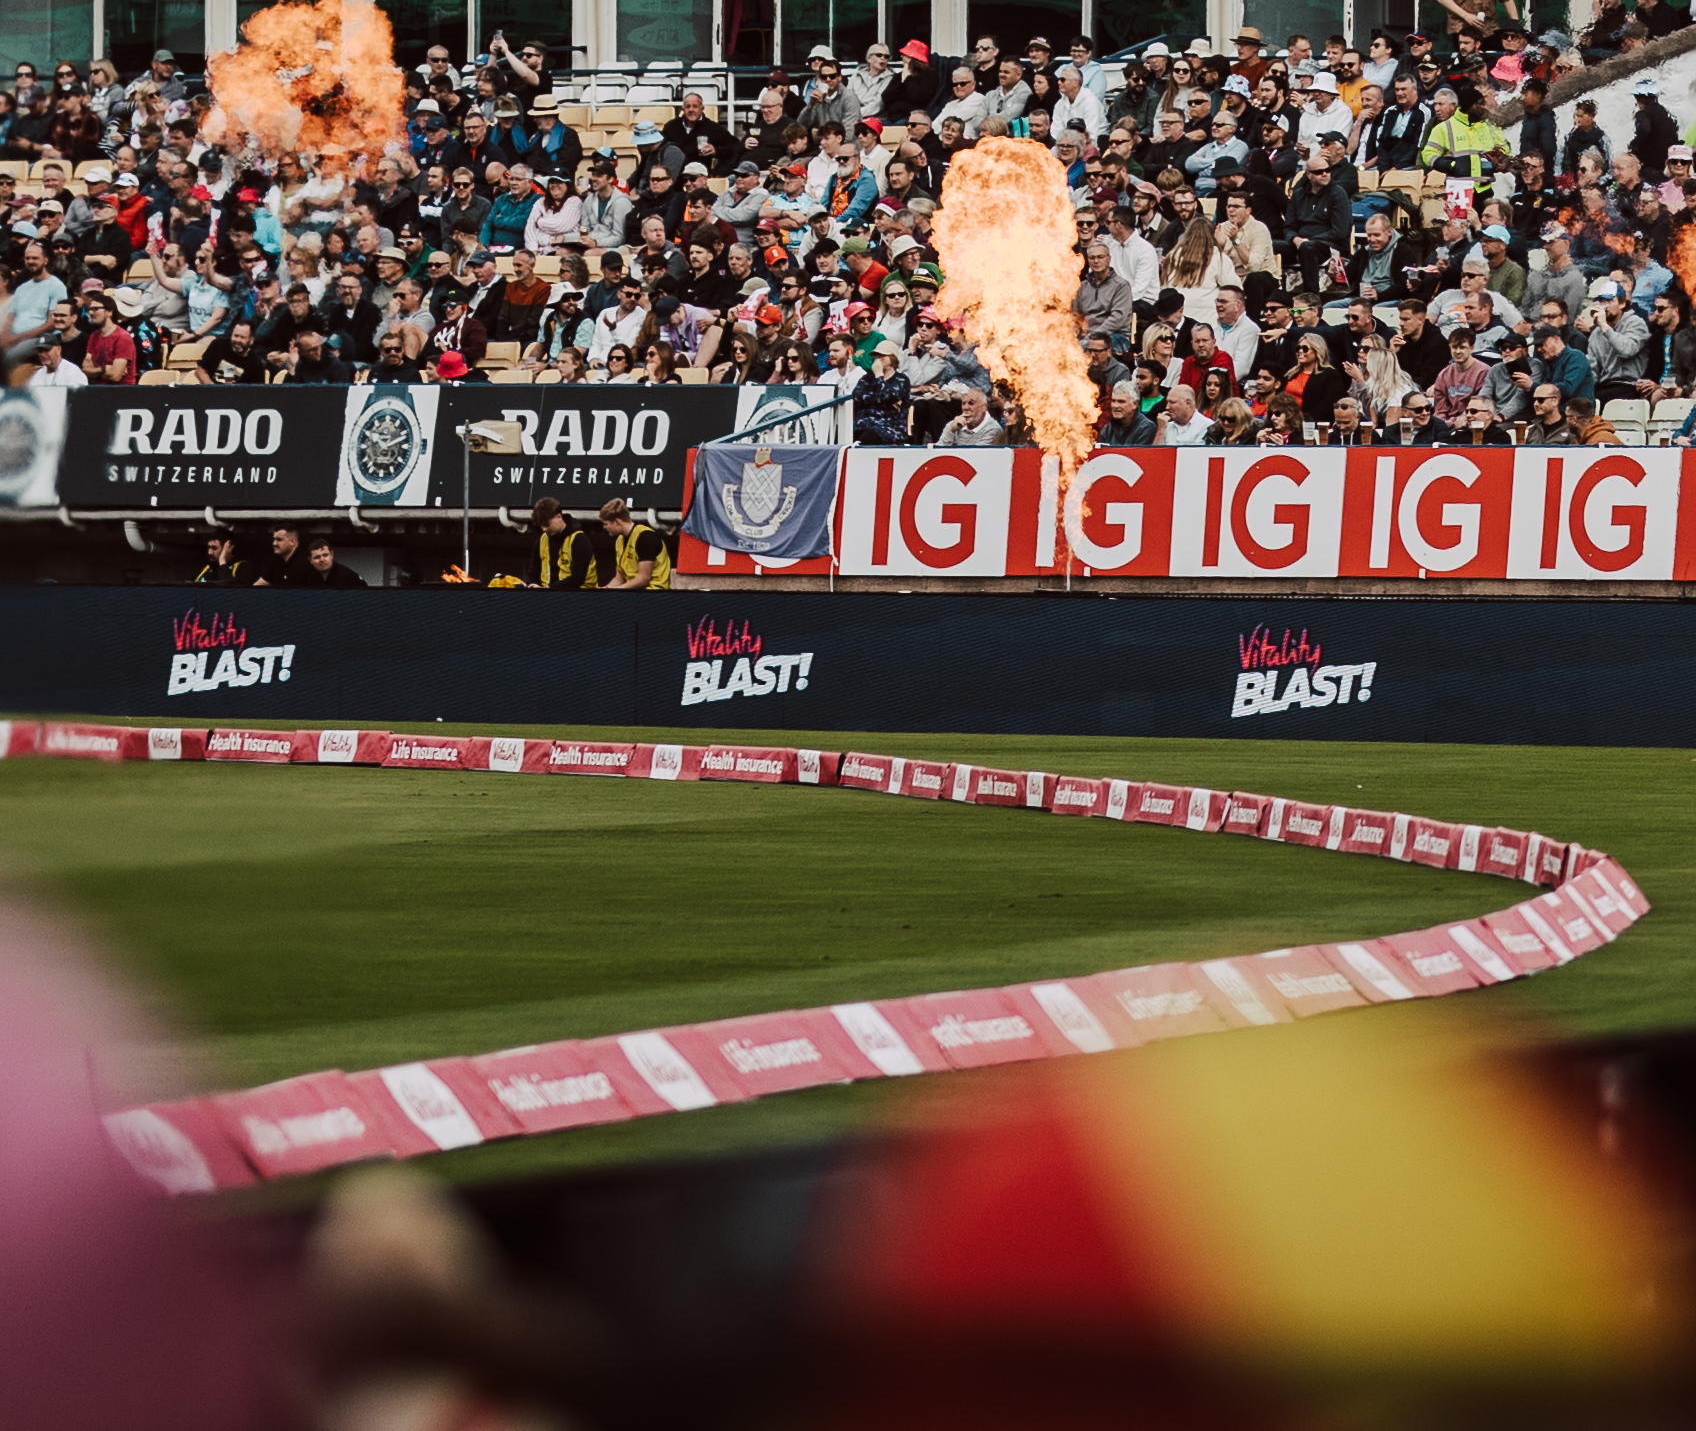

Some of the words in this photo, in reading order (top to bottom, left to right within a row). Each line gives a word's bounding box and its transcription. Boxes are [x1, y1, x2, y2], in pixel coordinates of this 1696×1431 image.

[110, 407, 284, 456] RADO
[502, 407, 671, 456] RADO
[107, 465, 278, 484] SWITZERLAND
[493, 466, 664, 486] SWITZERLAND
[871, 455, 978, 569] IG
[1035, 453, 1144, 569] IG
[1202, 454, 1311, 570] IG
[1369, 453, 1482, 572] IG
[1540, 454, 1647, 573] IG
[172, 610, 247, 654] Vitality
[687, 615, 762, 660] Vitality
[1239, 625, 1321, 673] Vitality
[167, 644, 296, 696] BLAST!
[680, 653, 814, 706] BLAST!
[1231, 662, 1377, 718] BLAST!
[209, 733, 242, 752] Health
[243, 734, 291, 754] insurance
[391, 740, 410, 760] Life
[411, 742, 458, 761] insurance
[550, 744, 582, 766] Health
[583, 746, 628, 767] insurance
[701, 751, 734, 771] Health
[735, 753, 783, 774] insurance
